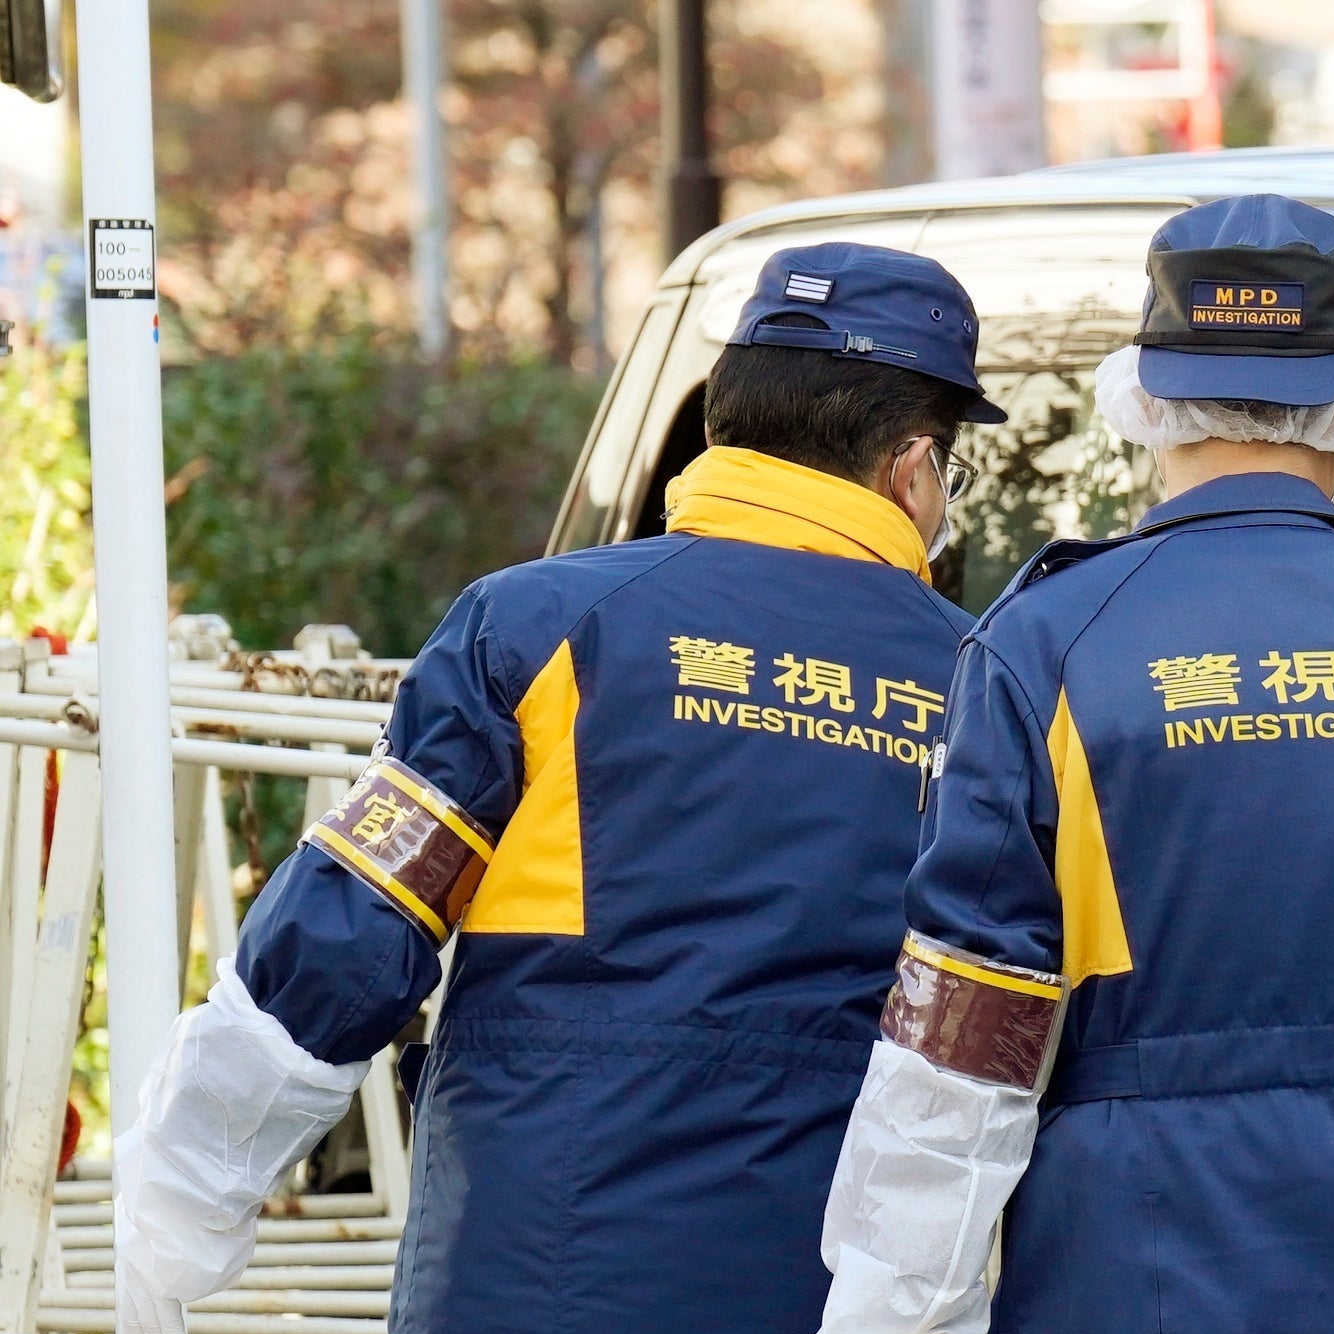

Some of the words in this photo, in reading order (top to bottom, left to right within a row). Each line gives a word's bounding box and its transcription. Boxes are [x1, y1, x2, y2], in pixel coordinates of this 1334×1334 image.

[1215, 287, 1279, 306] MPD
[1192, 310, 1301, 326] INVESTIGATION
[668, 635, 945, 733] 警視庁
